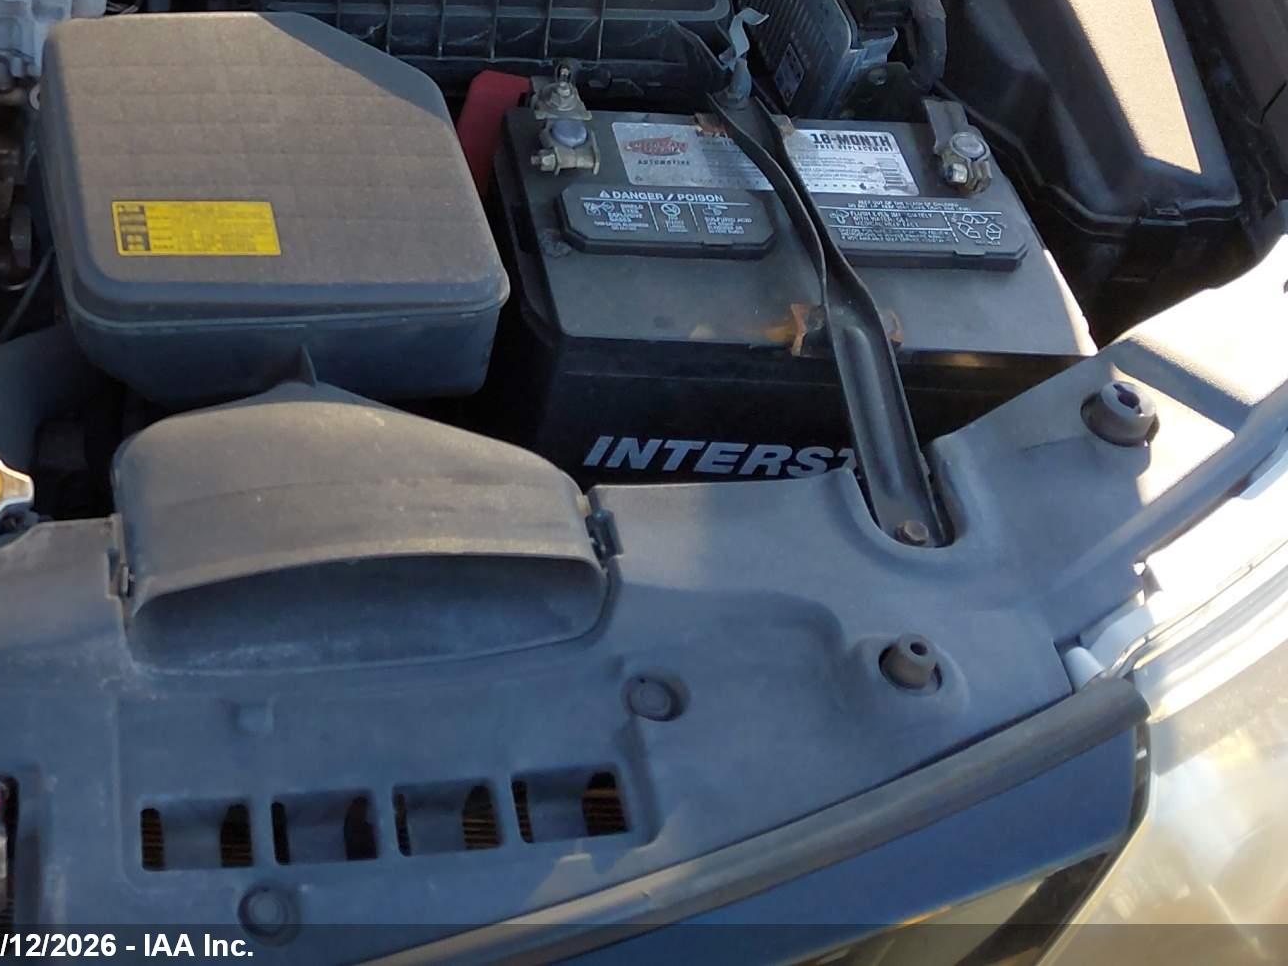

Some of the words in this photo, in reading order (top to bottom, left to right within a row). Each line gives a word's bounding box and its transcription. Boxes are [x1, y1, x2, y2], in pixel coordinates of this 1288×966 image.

[811, 133, 892, 151] 18-MONTH
[612, 191, 664, 201] DANGER
[677, 193, 724, 202] POISON
